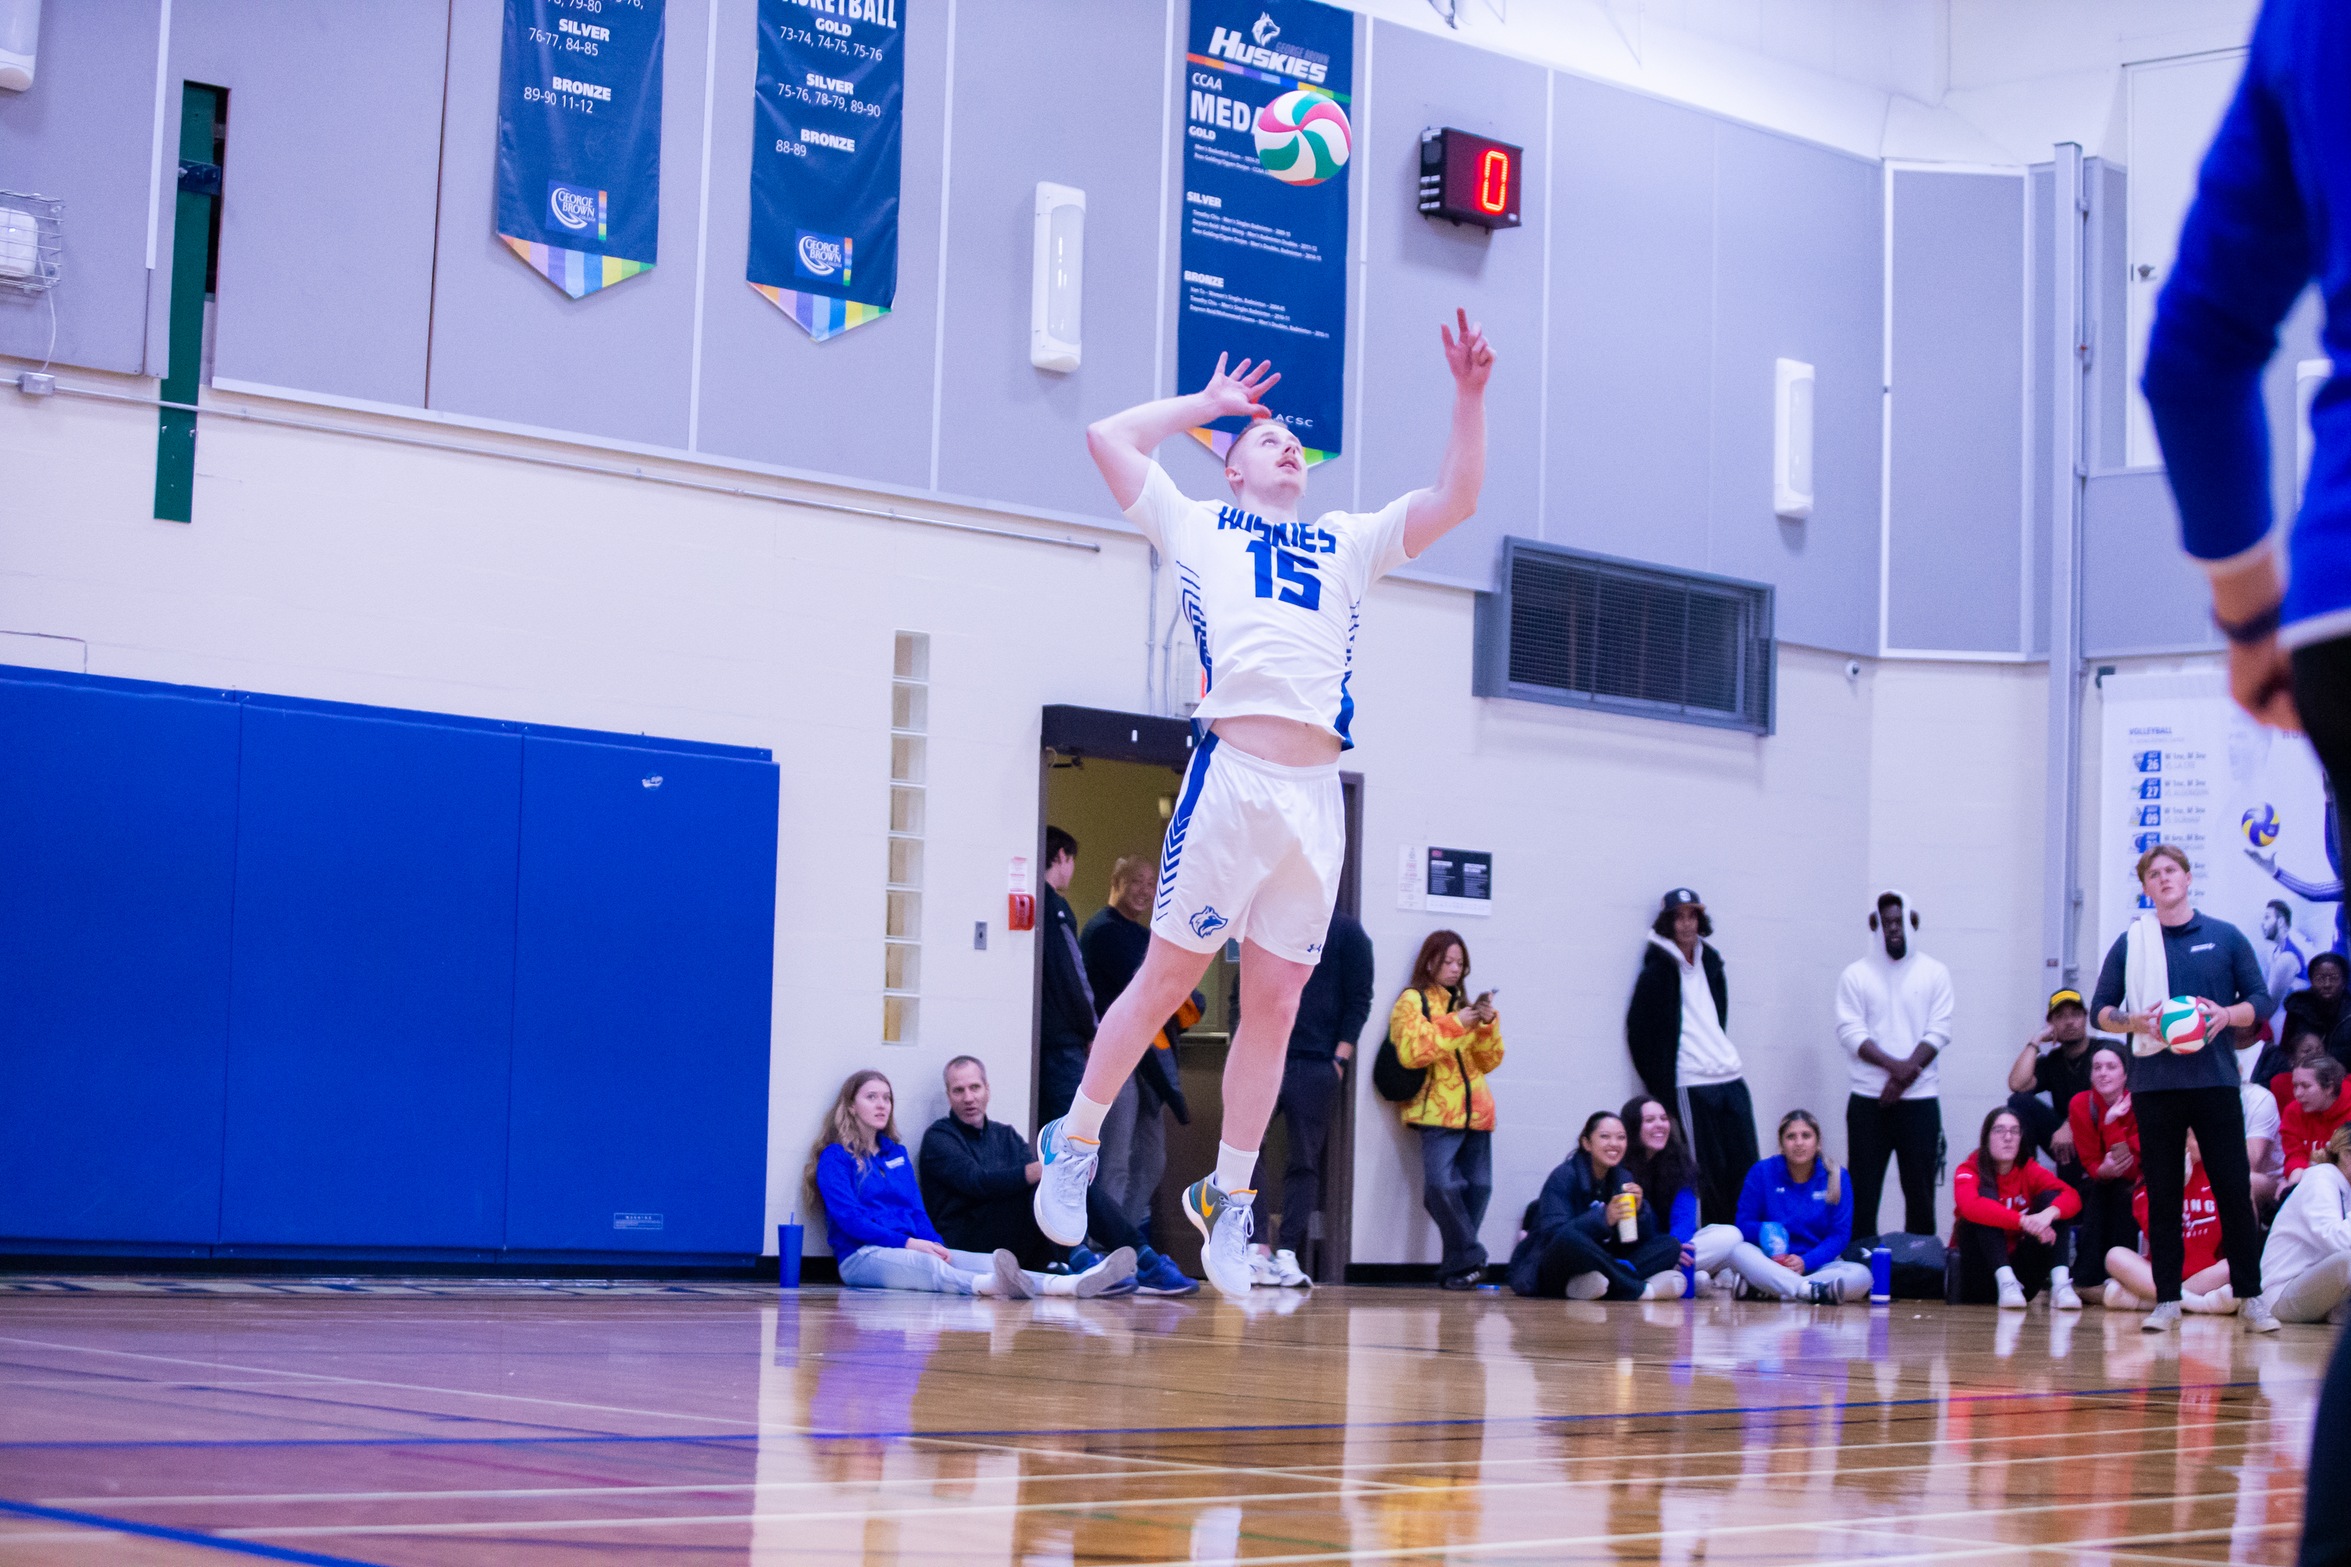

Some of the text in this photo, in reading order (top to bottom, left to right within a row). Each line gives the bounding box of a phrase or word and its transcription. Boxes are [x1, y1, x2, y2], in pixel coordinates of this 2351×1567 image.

[559, 18, 610, 42] SILVER
[815, 17, 852, 37] GOLD
[528, 27, 599, 57] 76-77, 84-85
[780, 26, 883, 61] 73-74, 74-75, 75-76
[1208, 26, 1328, 83] HUSKIES
[552, 76, 612, 101] BRONZE
[806, 73, 854, 95] SILVER
[1191, 72, 1222, 91] CCAA
[523, 86, 594, 114] 89-90 11-12
[778, 83, 881, 117] 75-76, 78-79, 89-90
[800, 129, 855, 152] BRONZE
[1188, 125, 1216, 140] GOLD
[775, 139, 807, 157] 88-89
[1482, 150, 1508, 211] 0
[558, 190, 594, 207] GEORGE
[562, 200, 595, 217] BROWN
[1187, 191, 1222, 208] SILVER
[805, 238, 840, 255] GEORGE
[810, 249, 842, 263] BROWN
[1184, 270, 1224, 288] BRONZE
[1245, 539, 1322, 611] 15
[2146, 786, 2159, 798] 27
